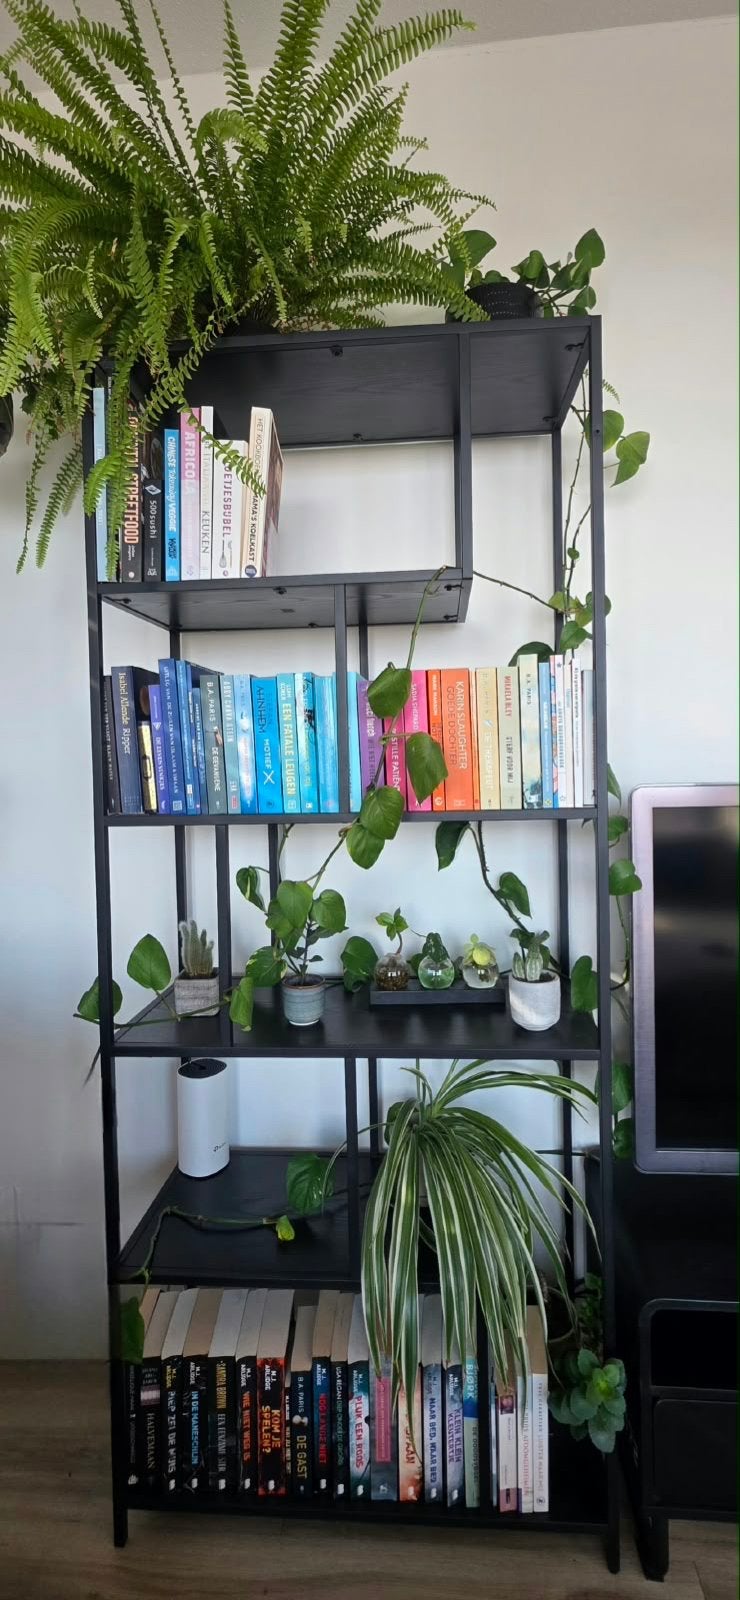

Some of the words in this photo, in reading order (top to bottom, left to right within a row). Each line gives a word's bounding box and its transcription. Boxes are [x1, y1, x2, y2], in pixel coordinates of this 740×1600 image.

[167, 436, 176, 467] CHINESE
[184, 432, 196, 495] AFRICOLA
[223, 467, 232, 537] OETJESBIJBEL
[168, 502, 176, 532] VEGGIE
[201, 511, 210, 554] KEUKEN
[248, 523, 257, 561] KOELKAST
[119, 672, 128, 694] Isabel
[223, 681, 231, 698] ABBY
[504, 676, 512, 700] MIKAELA
[166, 702, 172, 710] DE
[447, 686, 456, 718] GOEDE
[455, 681, 465, 710] KARIN
[120, 697, 129, 724] Allende
[208, 699, 216, 721] PARIS
[256, 686, 266, 733] AHNHEM
[282, 703, 292, 720] EEN
[122, 727, 131, 754] Ripper
[212, 747, 219, 755] DE
[284, 724, 294, 756] FATALE
[391, 738, 399, 760] STILLE
[448, 721, 457, 765] DOCHTER
[457, 713, 468, 769] SLAUGHTER
[212, 756, 220, 791] GEVANGENE
[263, 770, 275, 785] X
[286, 759, 296, 796] LEUGEN
[216, 1363, 226, 1385] SANDRA
[466, 1364, 474, 1399] BJØRK
[167, 1391, 176, 1411] PIEP
[191, 1391, 199, 1399] IN
[191, 1401, 199, 1412] DE
[216, 1387, 226, 1408] BROWN
[242, 1391, 250, 1408] WIE
[355, 1395, 363, 1418] PLUK
[167, 1414, 176, 1430] ZEI
[218, 1414, 226, 1425] EEN
[262, 1405, 271, 1453] SPELEN?
[271, 1410, 281, 1432] KOM
[319, 1413, 327, 1442] LANGE
[355, 1422, 363, 1440] EEN
[146, 1413, 156, 1469] HALVEMAAN
[168, 1432, 176, 1445] DE
[191, 1413, 199, 1464] MANESCHIJN
[272, 1436, 281, 1448] JE
[296, 1435, 307, 1449] DE
[168, 1449, 176, 1473] MUIS
[243, 1452, 250, 1460] IS
[319, 1443, 327, 1464] NIET
[297, 1452, 307, 1479] GAST
